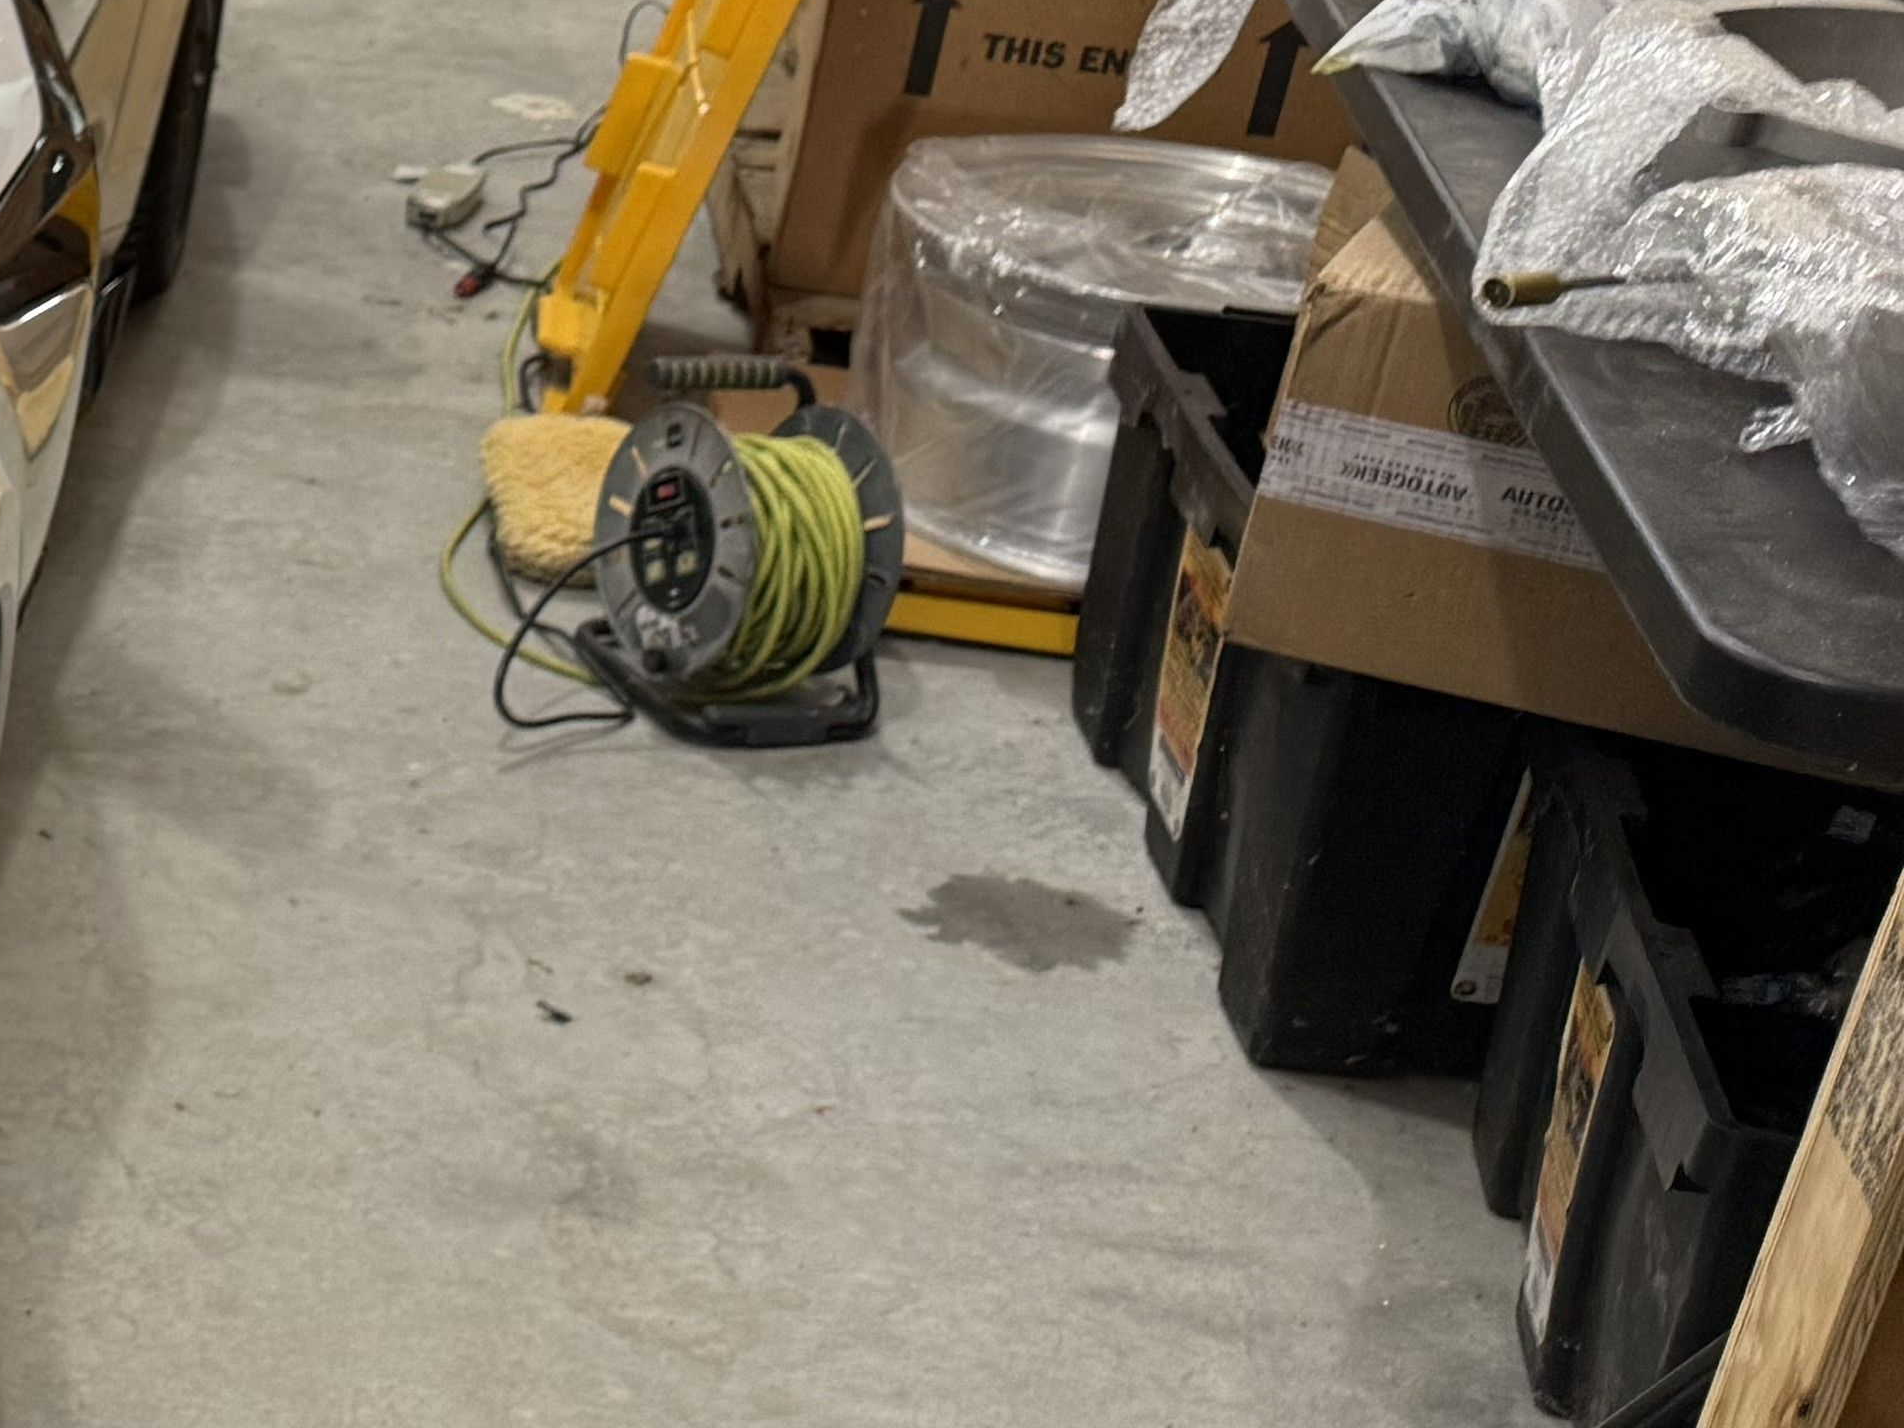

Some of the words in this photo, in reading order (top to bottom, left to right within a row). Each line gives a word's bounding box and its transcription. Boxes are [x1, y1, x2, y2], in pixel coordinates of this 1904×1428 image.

[985, 33, 1066, 69] THIS
[1079, 45, 1136, 76] EN
[1501, 486, 1572, 515] AUTO
